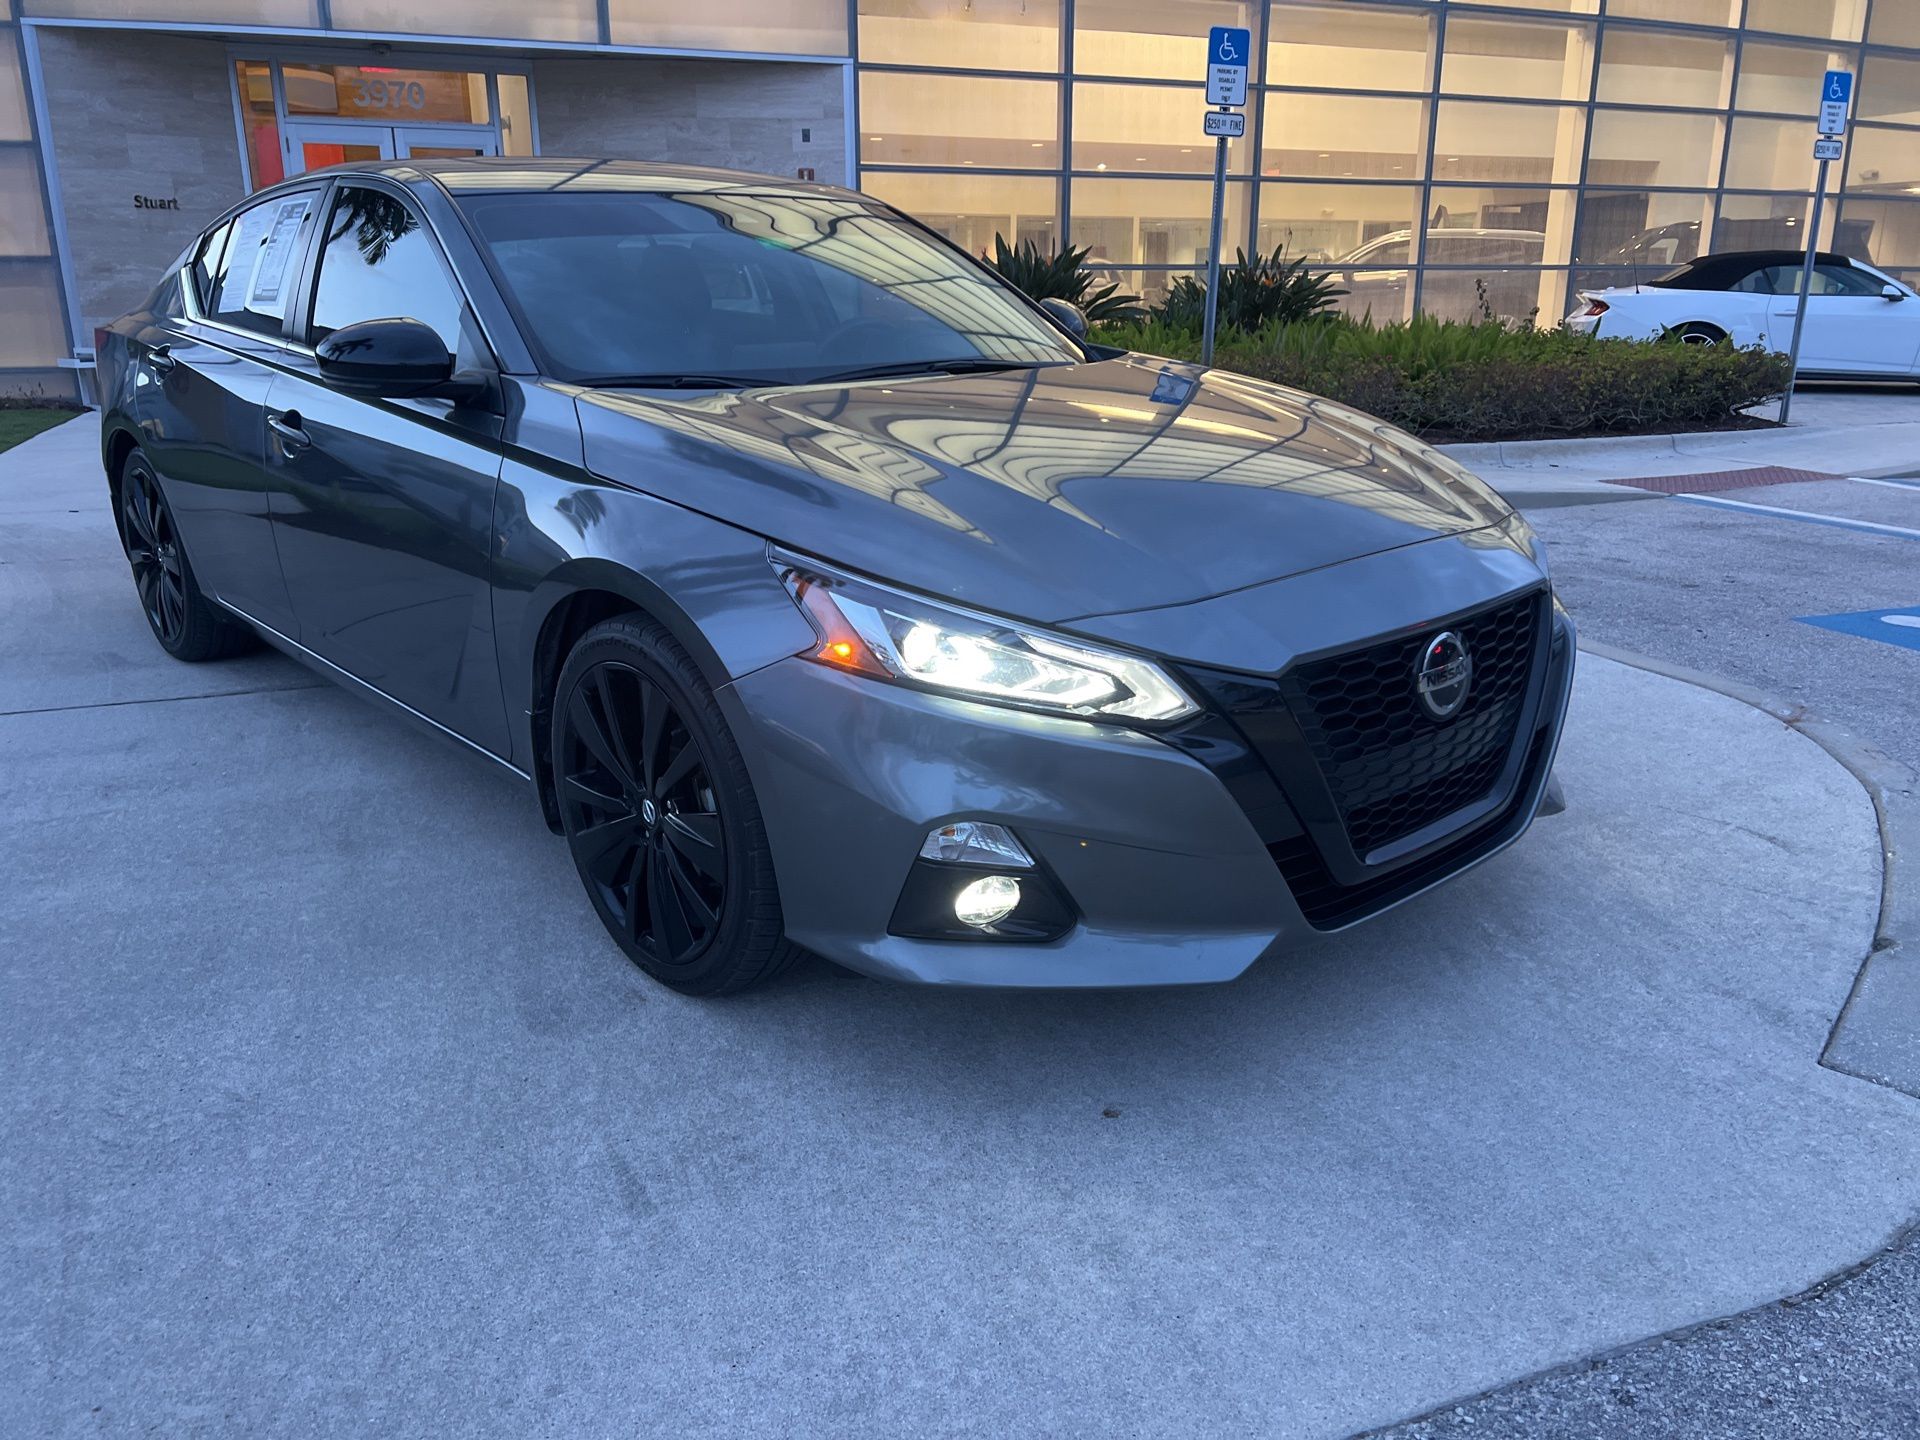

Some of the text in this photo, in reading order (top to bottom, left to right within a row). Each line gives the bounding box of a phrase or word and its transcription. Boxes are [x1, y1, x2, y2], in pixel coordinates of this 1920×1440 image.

[352, 79, 425, 110] 3970
[1207, 117, 1220, 129] $250
[1230, 119, 1242, 131] FINE
[134, 195, 180, 211] Stuart
